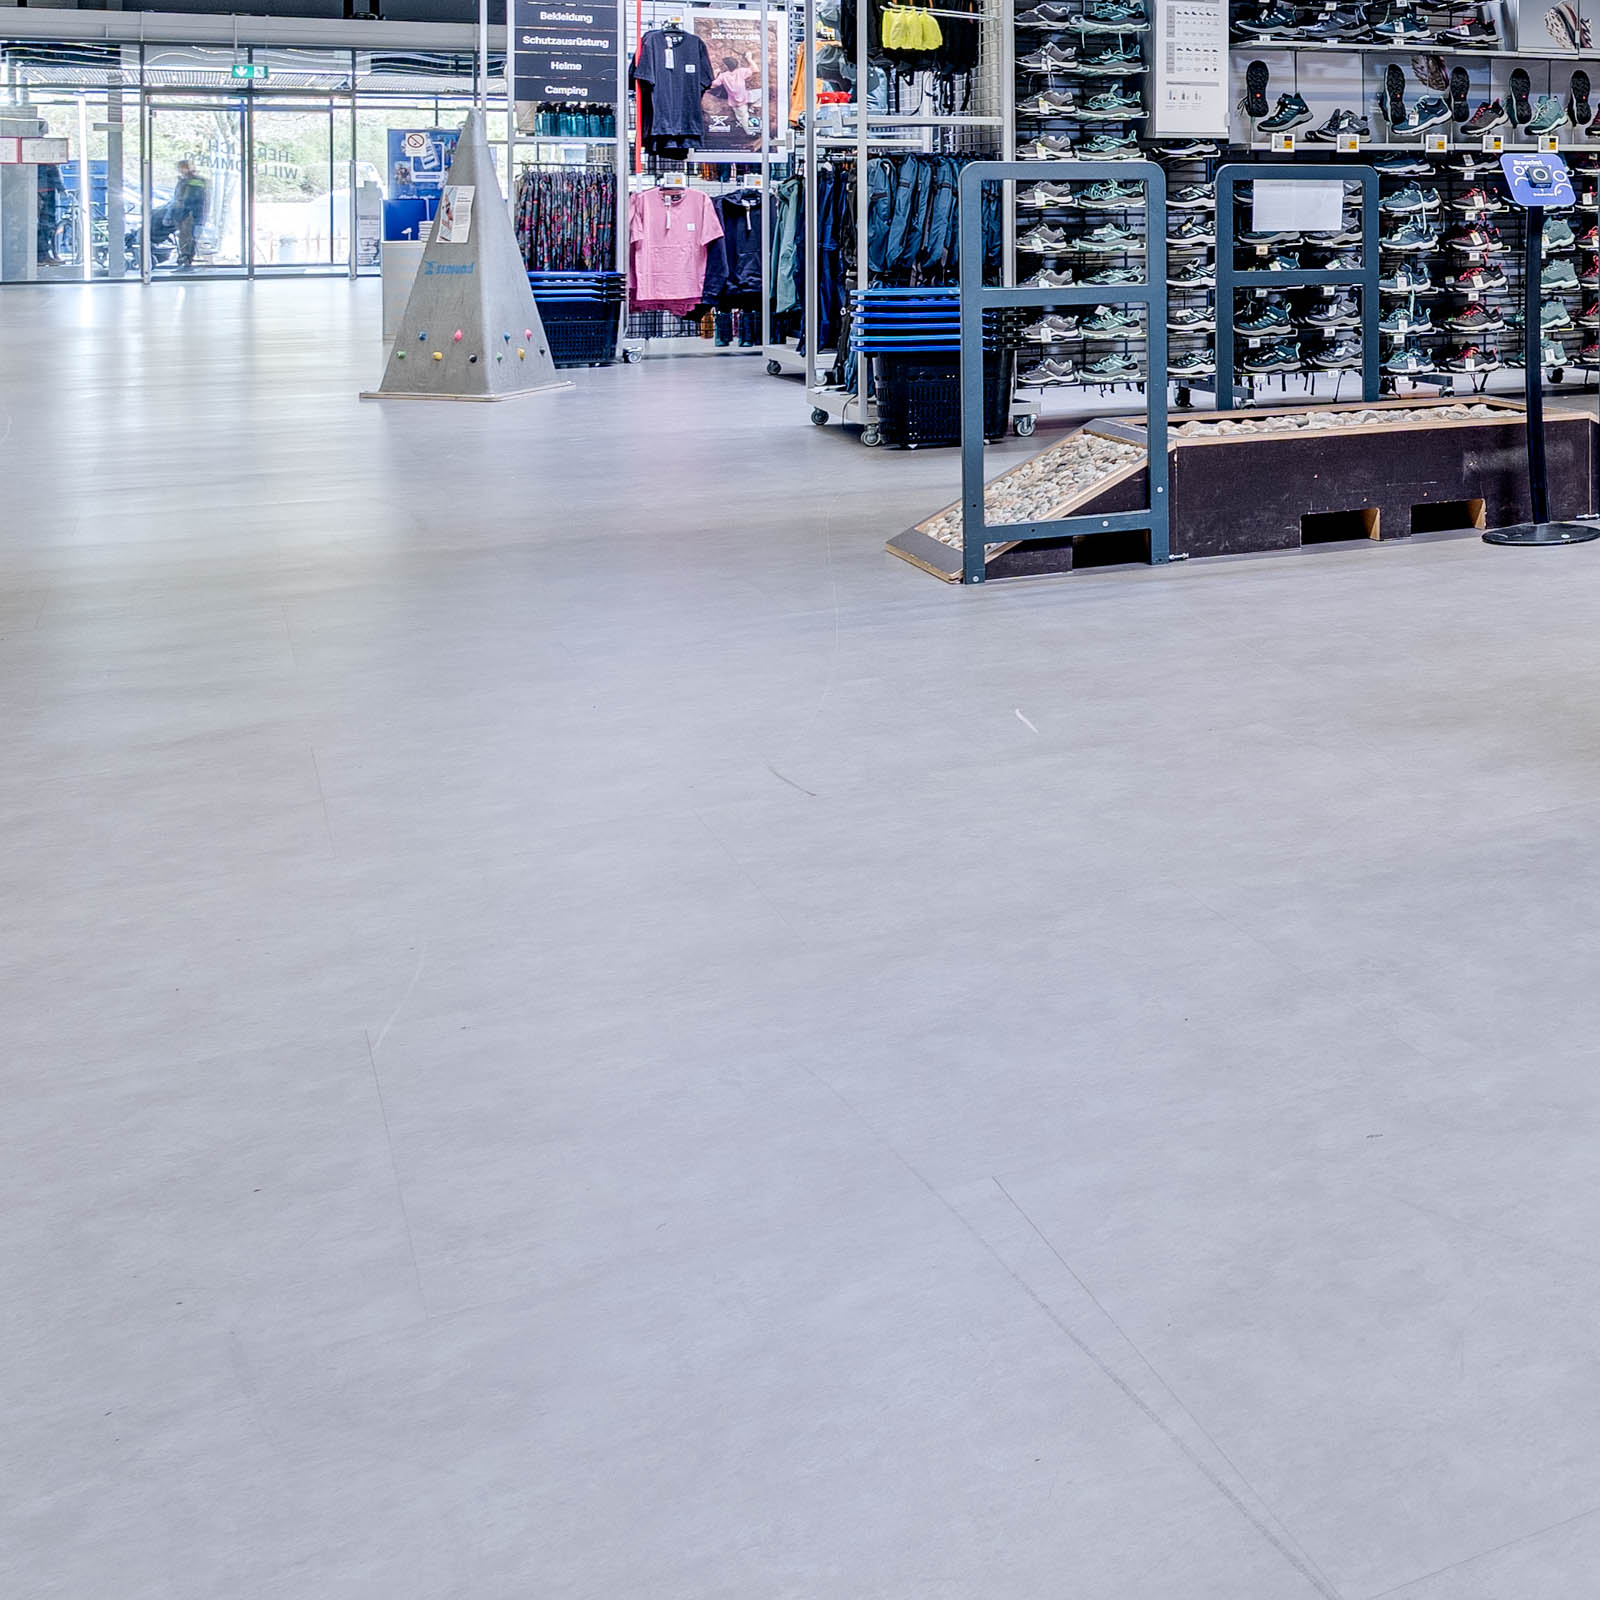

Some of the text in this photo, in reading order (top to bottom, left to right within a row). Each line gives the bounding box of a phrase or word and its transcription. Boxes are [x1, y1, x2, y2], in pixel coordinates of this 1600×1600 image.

[540, 11, 593, 24] Bekleidung
[522, 35, 610, 49] Schutzausrüstung
[550, 61, 582, 70] Helme
[545, 85, 588, 97] Camping
